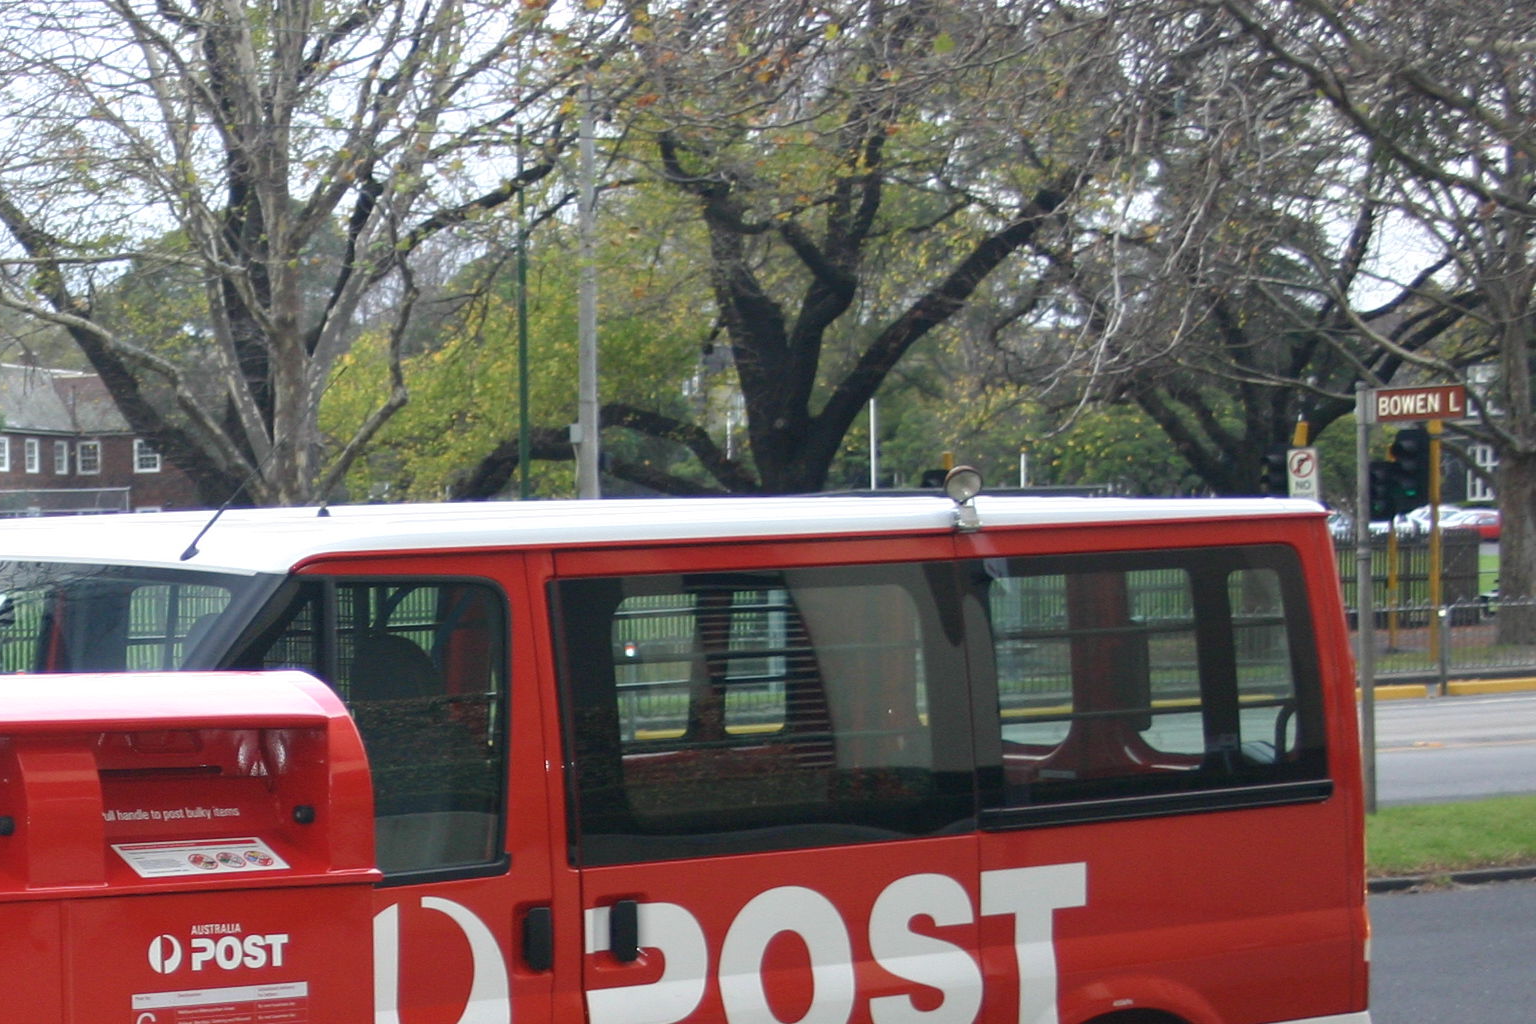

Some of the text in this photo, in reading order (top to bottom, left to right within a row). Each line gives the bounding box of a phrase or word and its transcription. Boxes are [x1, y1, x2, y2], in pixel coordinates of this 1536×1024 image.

[1378, 391, 1460, 416] BOWEN L
[1295, 480, 1312, 490] NO
[102, 806, 240, 822] ull handle to post bulky items
[191, 923, 242, 935] AUSTRALIA
[191, 933, 289, 971] POST
